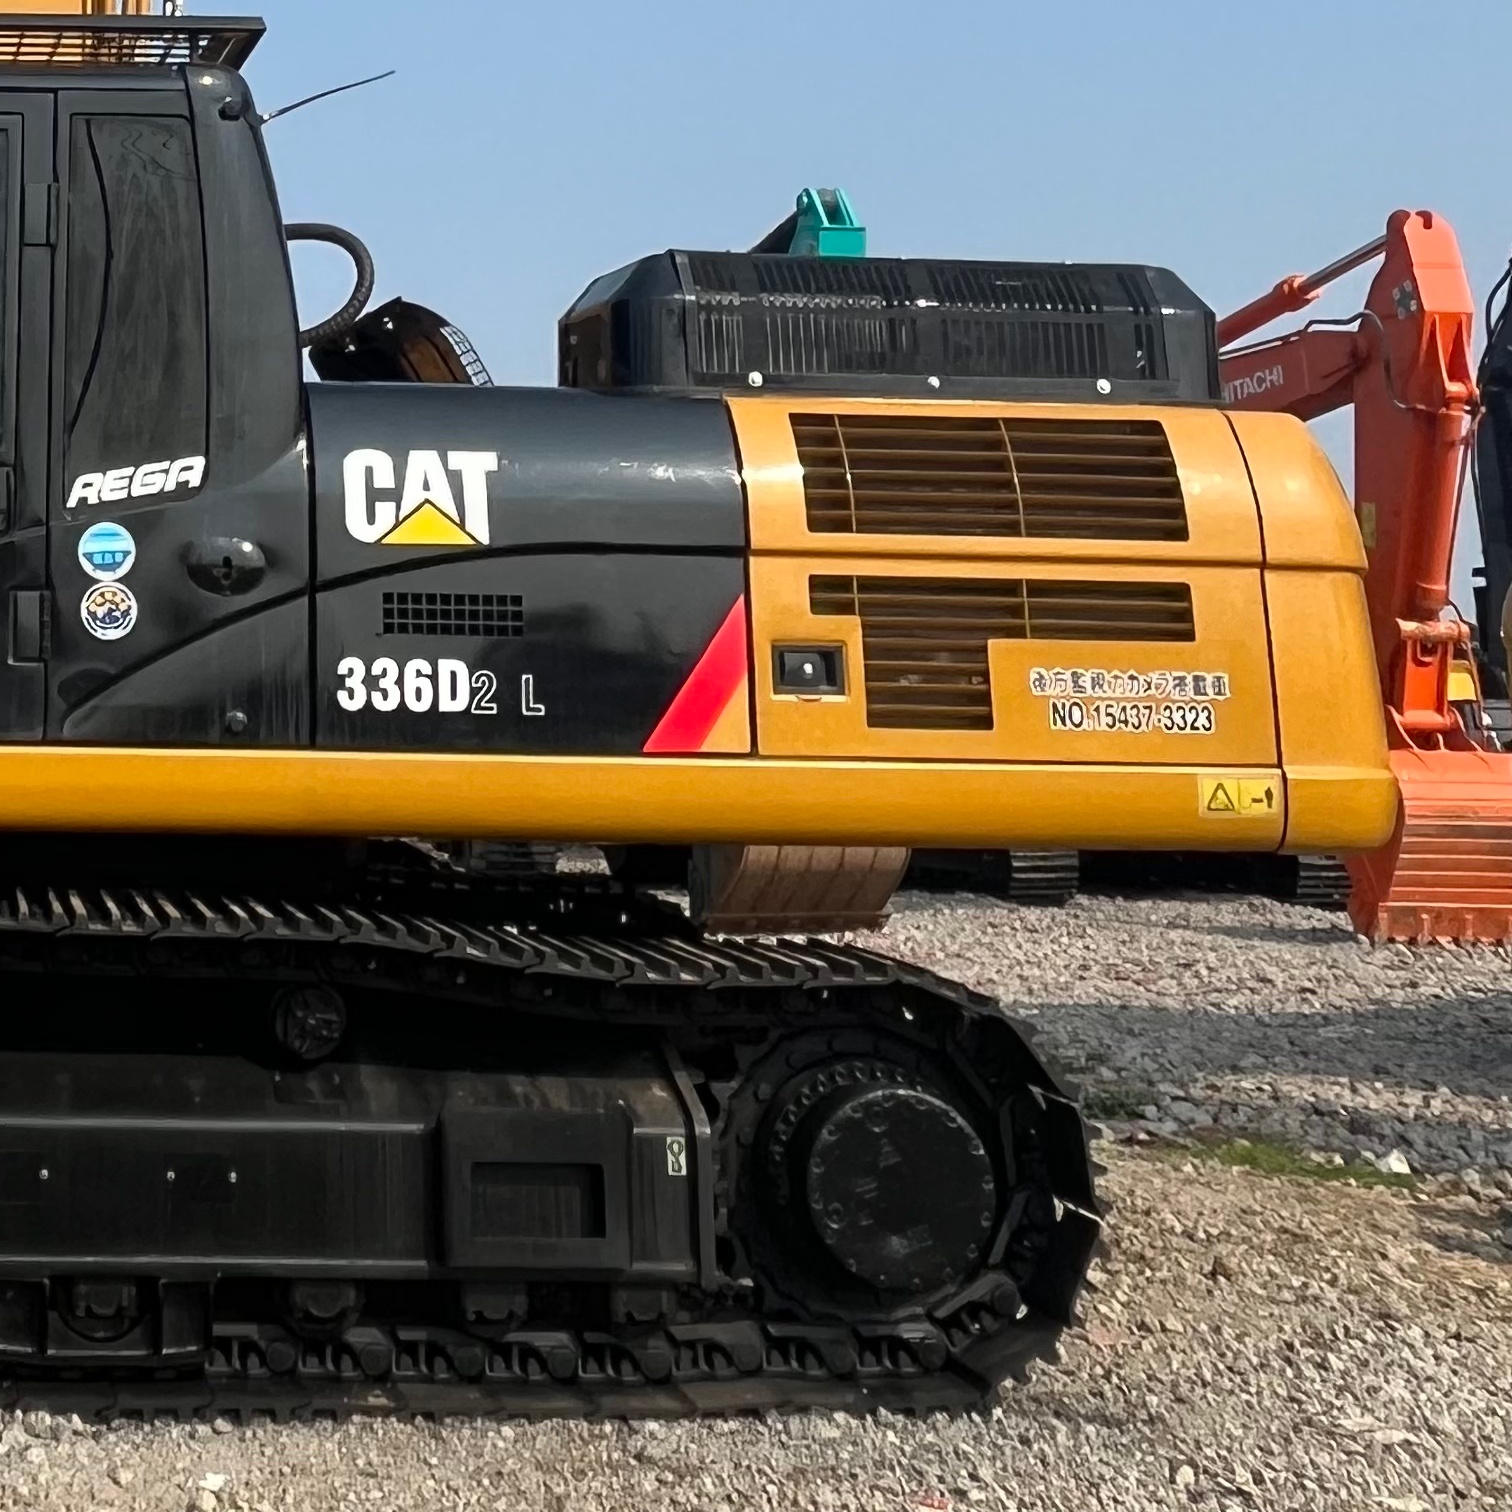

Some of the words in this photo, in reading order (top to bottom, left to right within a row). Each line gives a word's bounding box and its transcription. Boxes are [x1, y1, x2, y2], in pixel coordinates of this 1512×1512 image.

[65, 455, 206, 509] REGA
[342, 448, 499, 546] CAT
[521, 674, 546, 716] L
